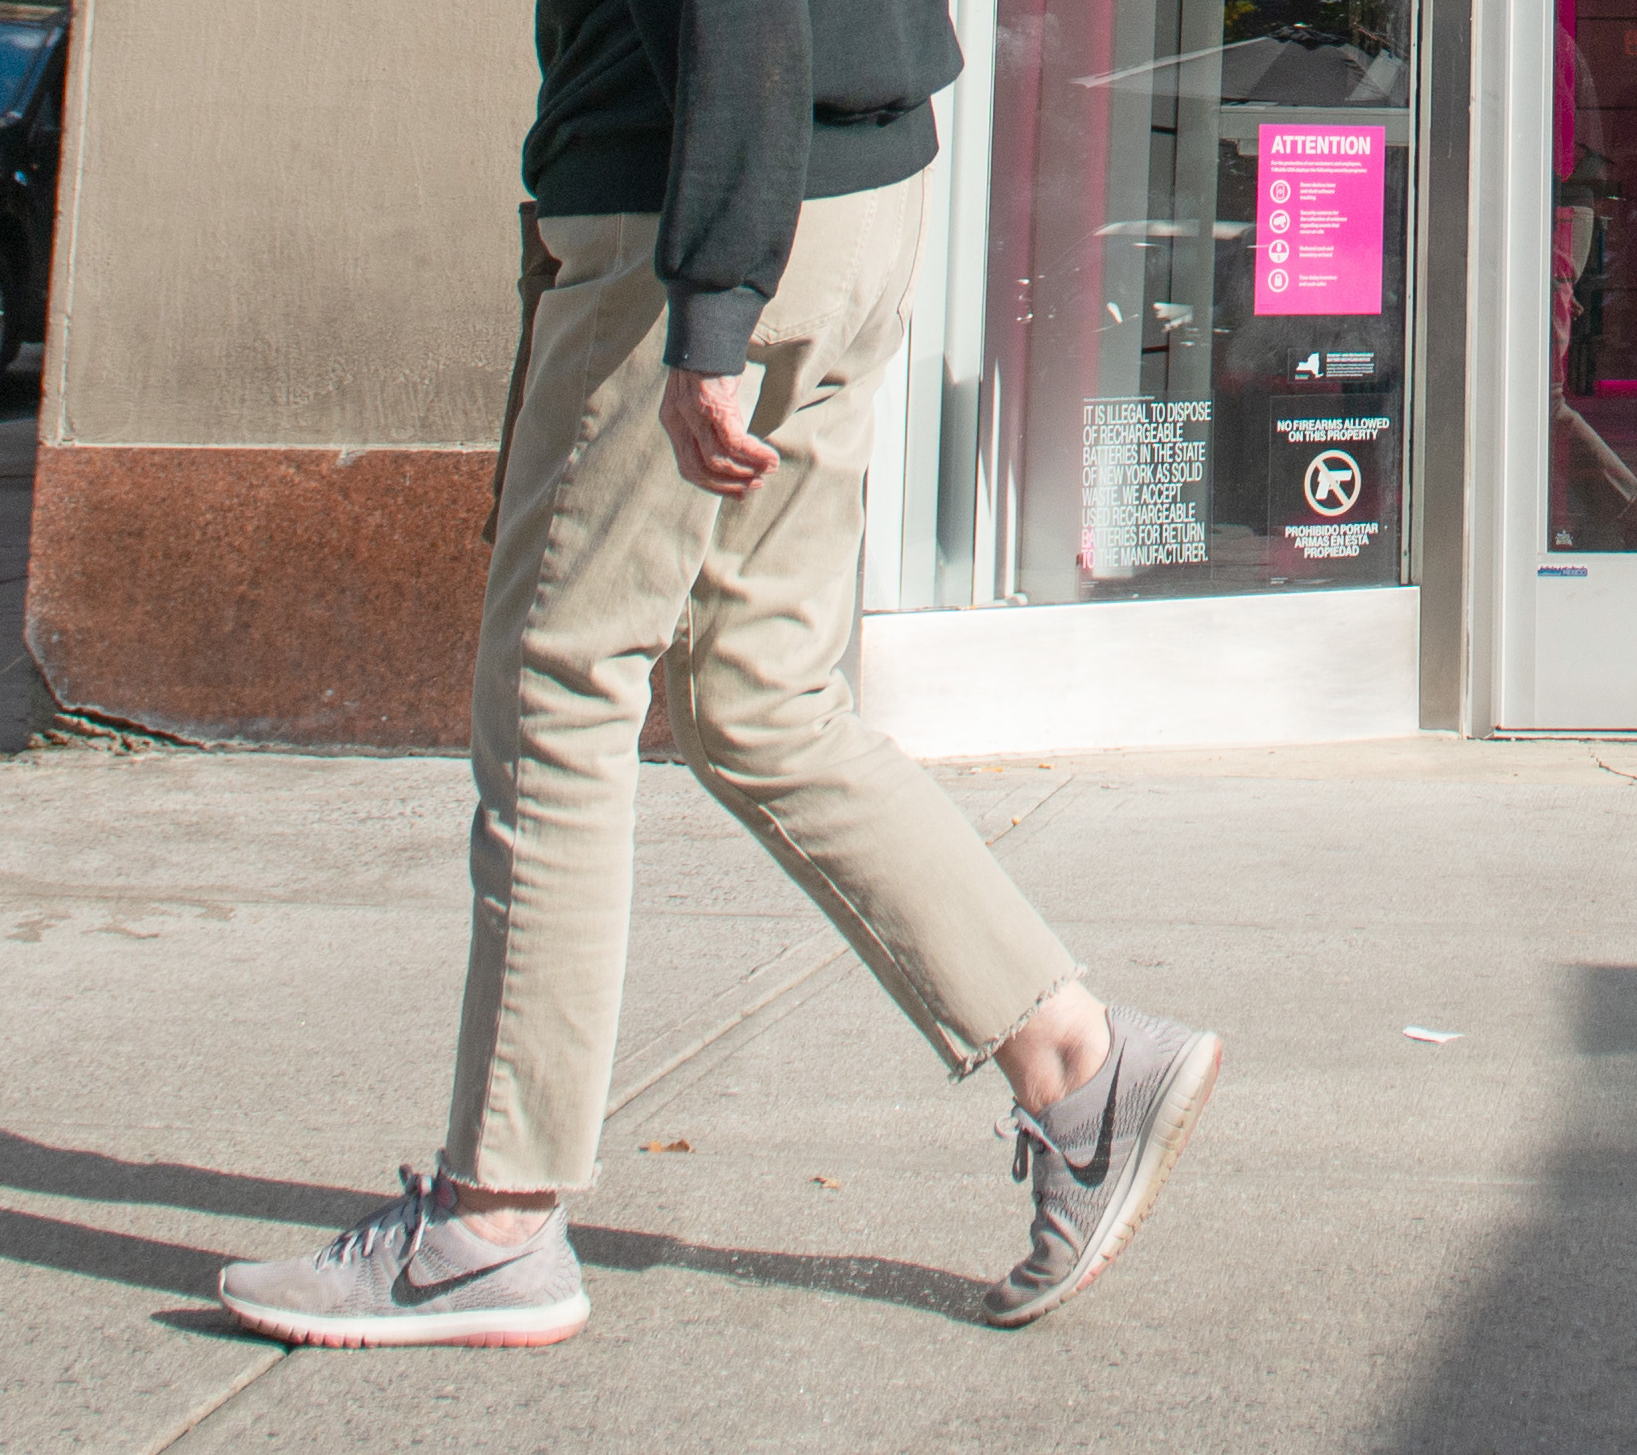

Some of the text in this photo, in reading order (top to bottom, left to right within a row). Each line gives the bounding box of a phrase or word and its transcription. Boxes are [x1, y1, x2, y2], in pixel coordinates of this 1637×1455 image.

[1271, 136, 1371, 155] ATTENTION
[1084, 402, 1211, 424] IT IS ILLEGAL TO DISPOSE
[1083, 423, 1183, 445] OF RECHARGEABLE
[1277, 418, 1389, 432] NO FIREARMS ALLOWED
[1288, 429, 1378, 442] ON THIS PROPERTY
[1083, 442, 1205, 466] BATTERIES IN THE STATE
[1083, 462, 1202, 486] OF NEW YORK AS SOLID
[1123, 486, 1139, 504] WE
[1141, 483, 1183, 504] ACCEPT
[1082, 503, 1195, 527] USED RECHARGEABLE
[1082, 522, 1205, 548] BATTERIES FOR RETURN
[1285, 523, 1378, 537] PROHIBIDO PORTAR
[1294, 534, 1369, 548] ARMAS EN ESTA
[1082, 543, 1208, 568] TO THE MANUFACTURER.
[1304, 546, 1359, 558] PROPIEDAD
